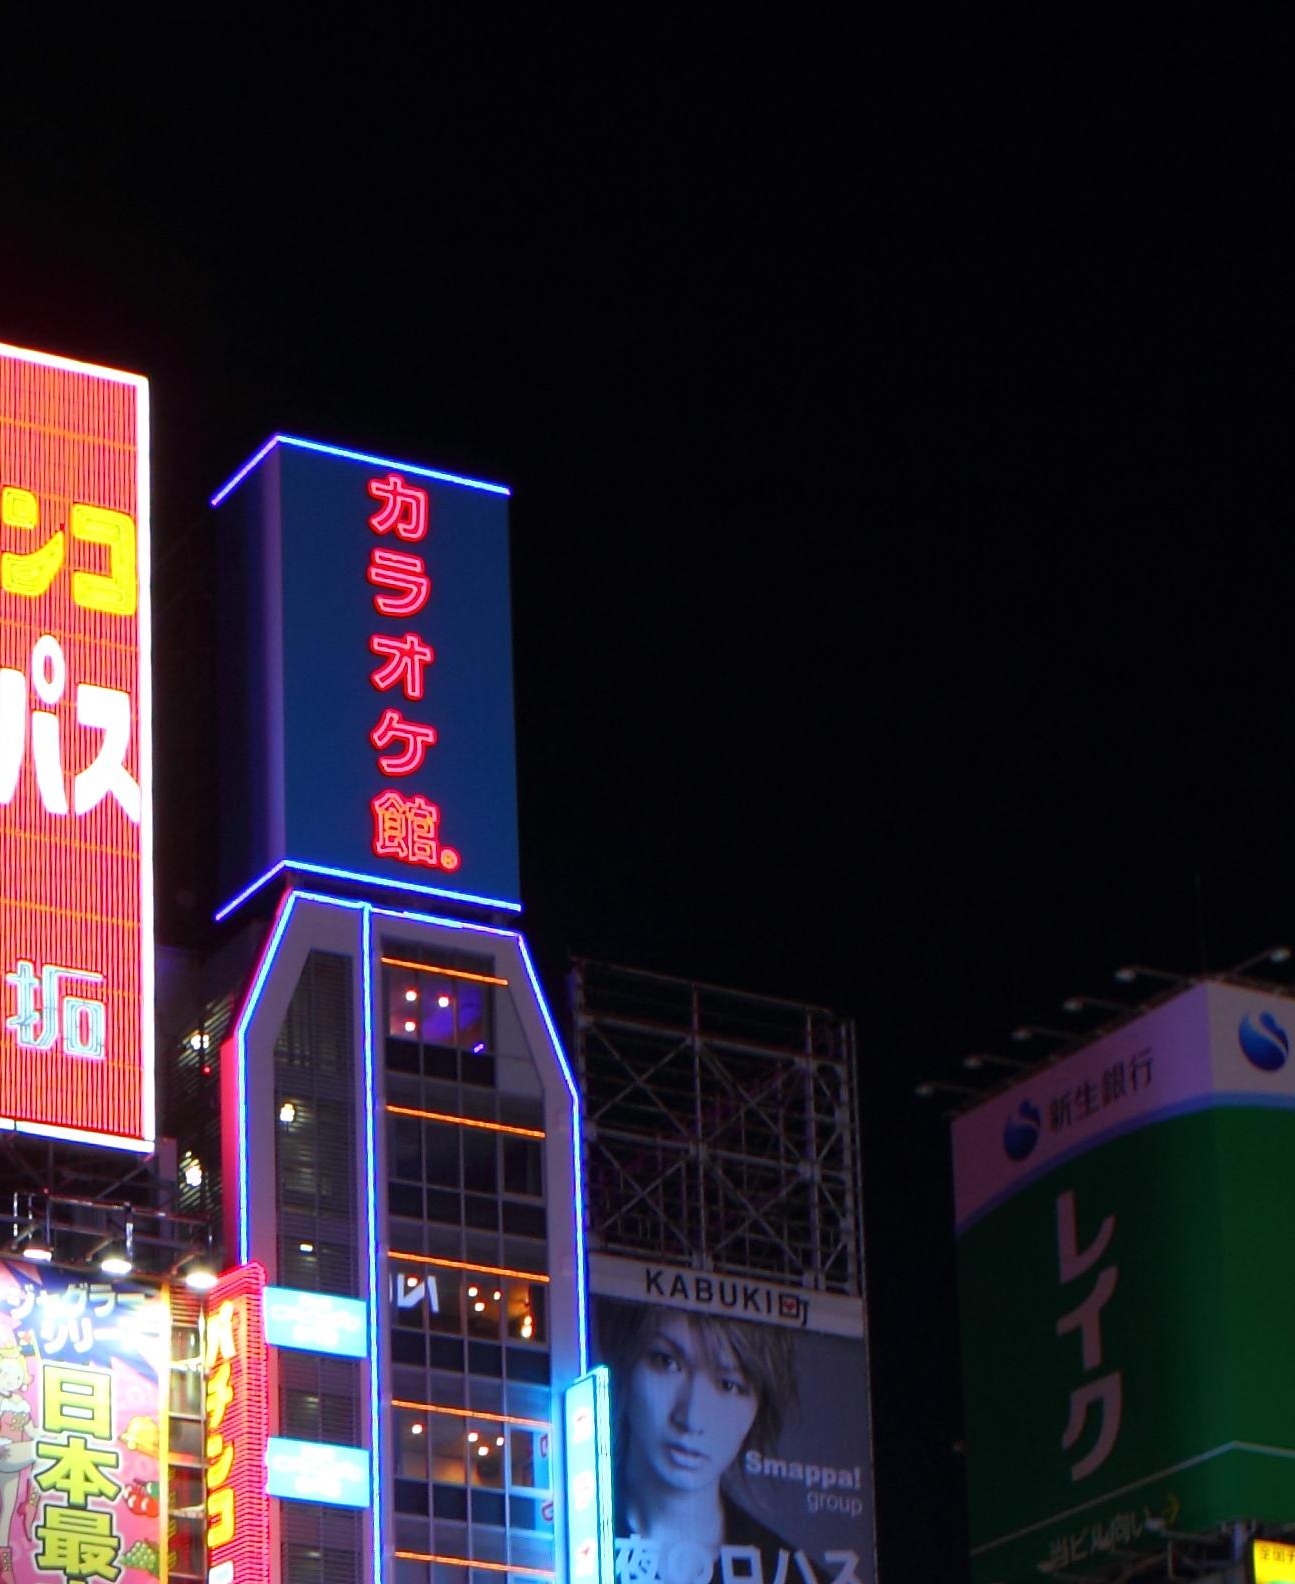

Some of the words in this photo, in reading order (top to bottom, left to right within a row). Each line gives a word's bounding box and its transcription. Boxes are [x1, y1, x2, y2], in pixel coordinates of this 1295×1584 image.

[368, 473, 440, 868] カラオケ館
[206, 1300, 236, 1548] パチンコ
[1056, 1189, 1123, 1483] レイク
[807, 1491, 863, 1518] group
